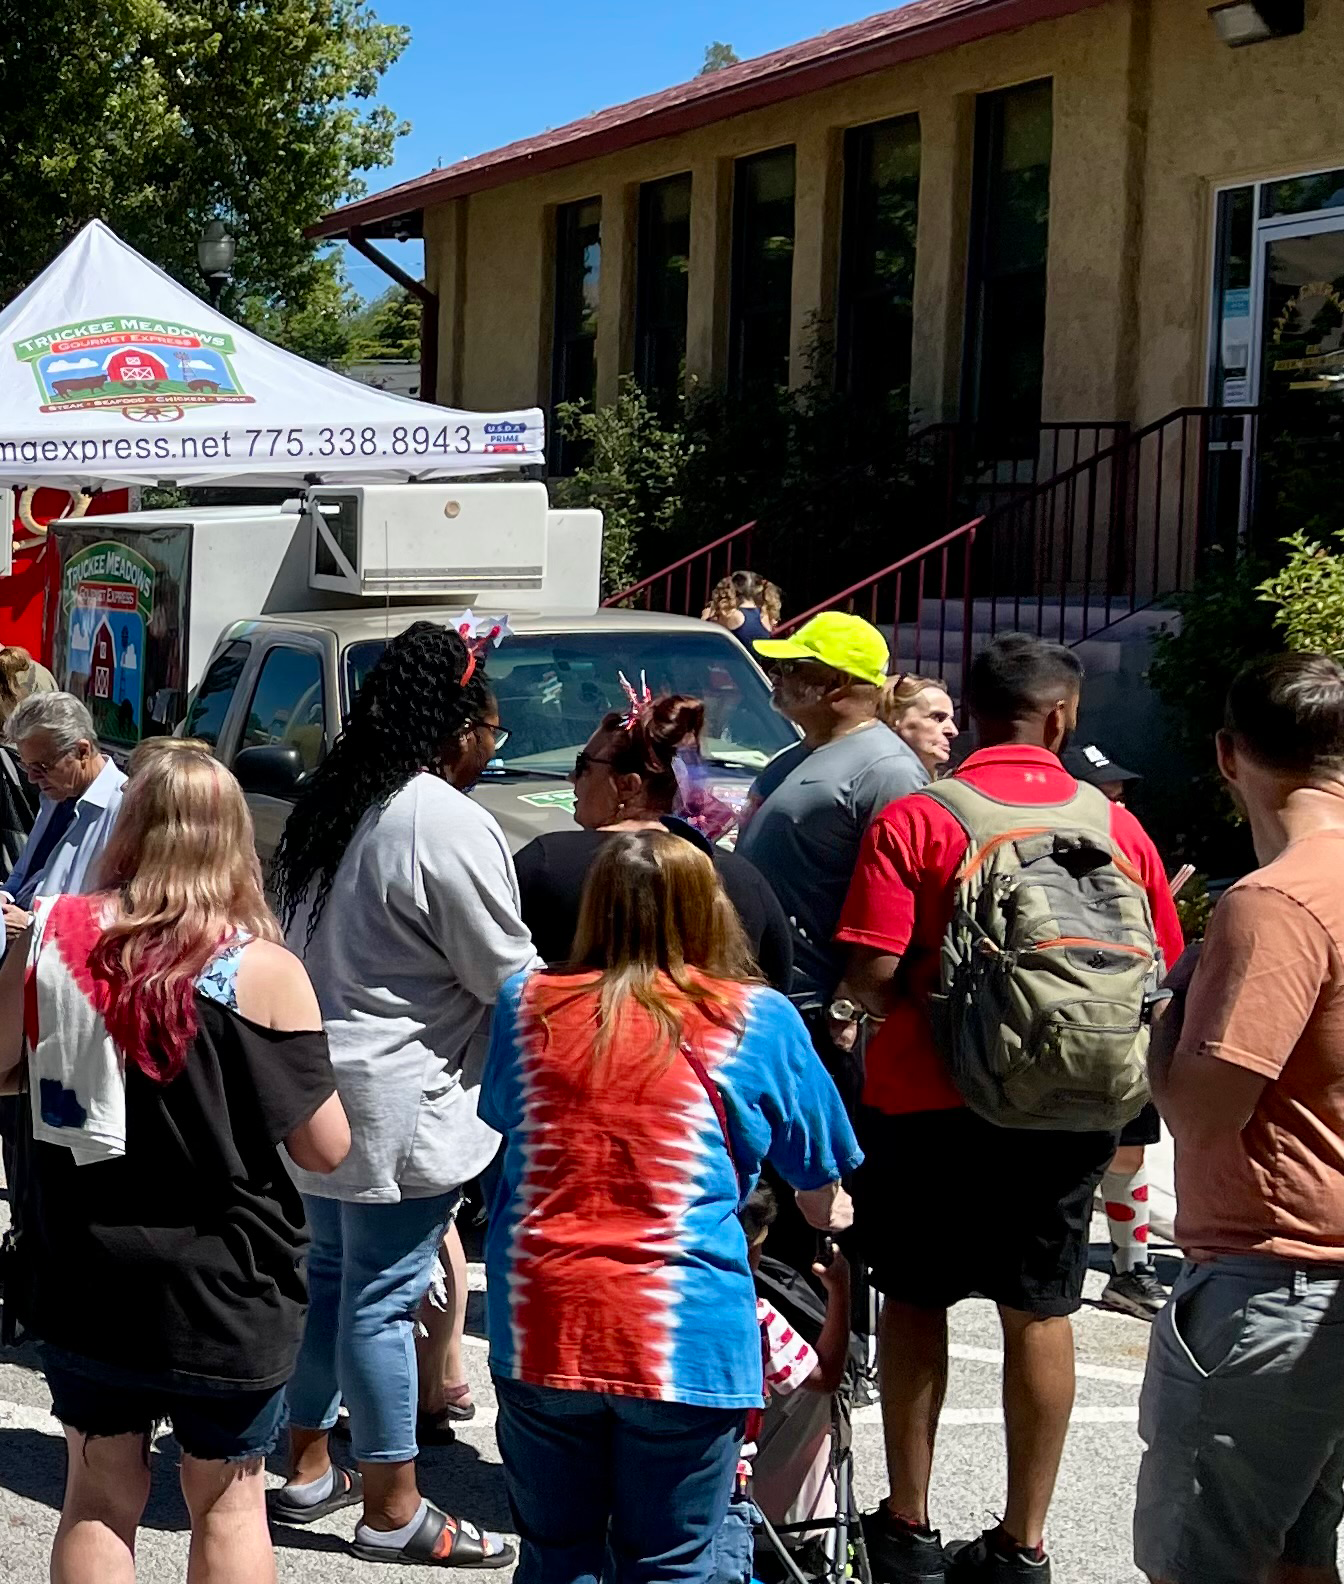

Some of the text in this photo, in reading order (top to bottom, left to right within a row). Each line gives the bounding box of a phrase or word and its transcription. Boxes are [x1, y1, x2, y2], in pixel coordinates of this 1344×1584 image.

[18, 322, 116, 352] TRUCKEE
[120, 319, 225, 347] MEADOWS
[58, 334, 191, 350] GOURMET EXPRESS
[48, 402, 84, 411] STEAK
[94, 396, 146, 406] SEAFOOD
[155, 396, 206, 404] CHICKEN
[245, 425, 472, 458] 775.338.8943
[490, 435, 520, 443] PRIME
[67, 551, 151, 598] TRUCKEE MEADOWS
